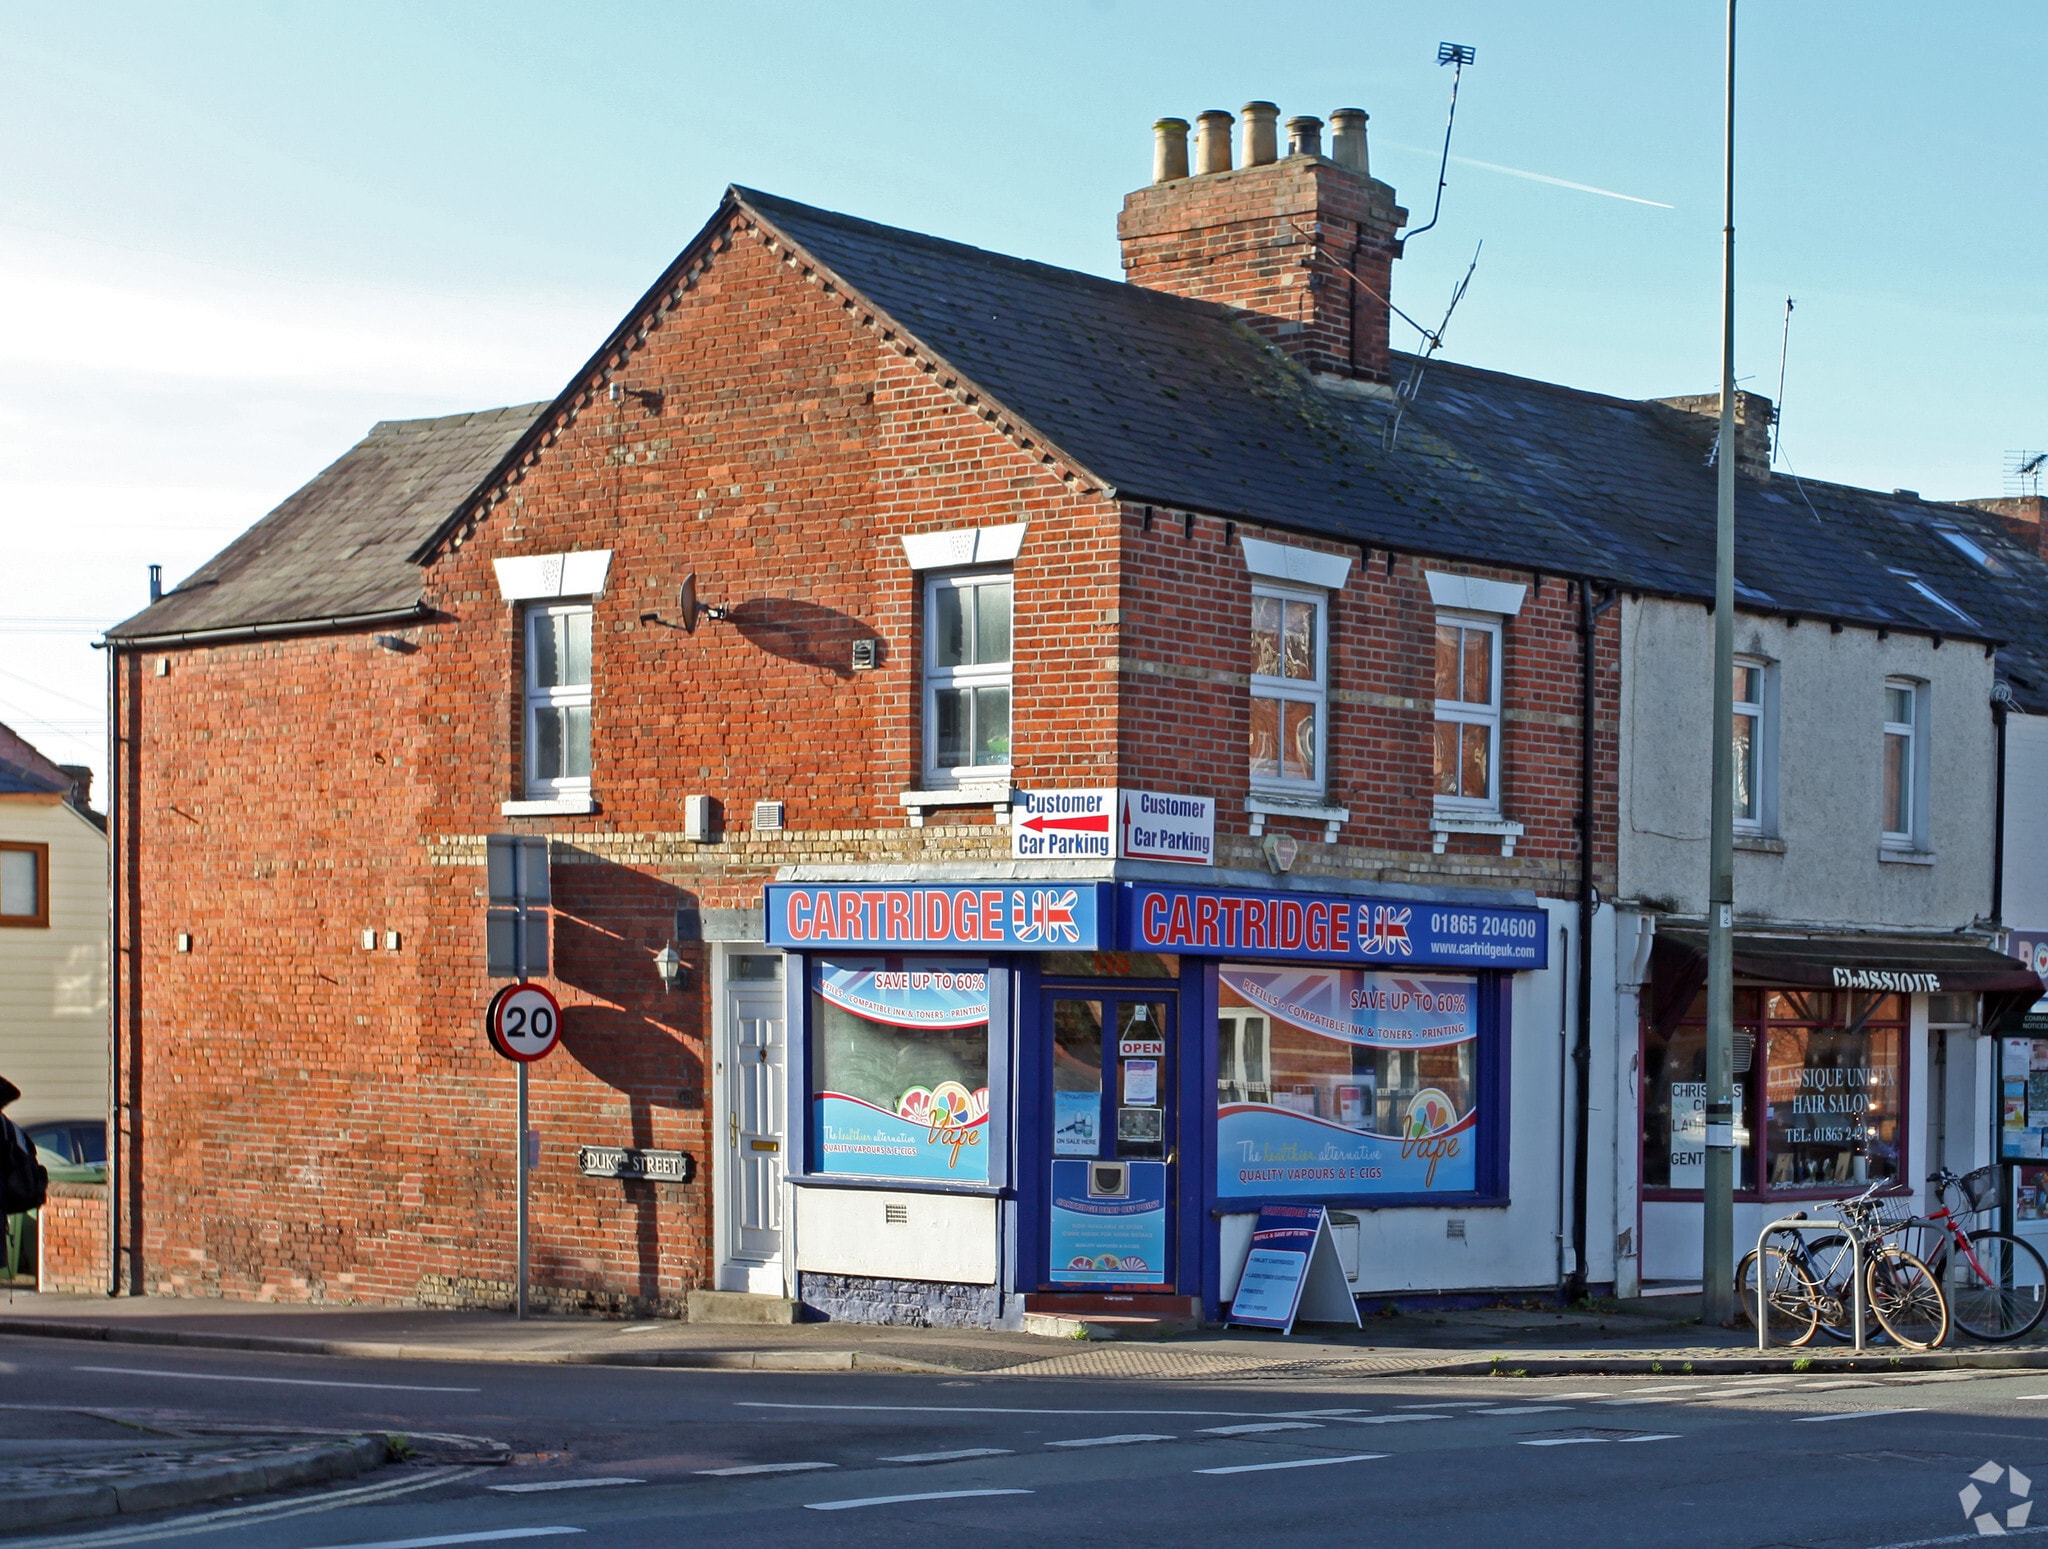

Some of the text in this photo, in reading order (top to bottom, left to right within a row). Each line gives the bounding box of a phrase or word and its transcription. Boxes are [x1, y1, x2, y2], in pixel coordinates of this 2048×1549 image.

[1026, 793, 1103, 814] Customer
[1141, 793, 1206, 819] Customer
[1018, 834, 1109, 856] Car Parking
[1134, 826, 1209, 855] Car Parking
[787, 889, 1081, 943] CARTRIDGE UK
[1141, 892, 1413, 956] CARTRIDGE UK
[1431, 913, 1536, 938] 01865 204600
[1431, 942, 1535, 959] www.cartridgeuk.com
[875, 973, 985, 990] SAVE UP TO 60%
[819, 979, 987, 1019] REFILLS COMPATIBLE INK & TONERS PRINTING
[1243, 979, 1464, 1039] REFILLS COMPATIBLE INK & TONERS PRINTING
[1351, 990, 1466, 1013] SAVE UP TO 60%
[506, 1007, 553, 1038] 20
[1122, 1043, 1163, 1054] OPEN
[1768, 1067, 1895, 1092] CLASSIQUE UNISEX
[1672, 1084, 1742, 1098] CHRISS
[1792, 1093, 1873, 1114] HAIR SALON
[824, 1126, 838, 1139] The
[873, 1130, 916, 1144] alternative
[927, 1109, 982, 1169] Vape
[1785, 1128, 1811, 1143] TEL:
[1814, 1127, 1843, 1142] 01865
[823, 1144, 852, 1153] QUALITY
[854, 1145, 885, 1154] VAPOURS
[1236, 1140, 1382, 1162] The healthier alternative
[1401, 1114, 1461, 1188] Vape
[1671, 1152, 1705, 1165] GENT
[587, 1152, 679, 1174] DUKE STREET
[1239, 1167, 1382, 1183] QUALITY VAPOURS & E-CIGS
